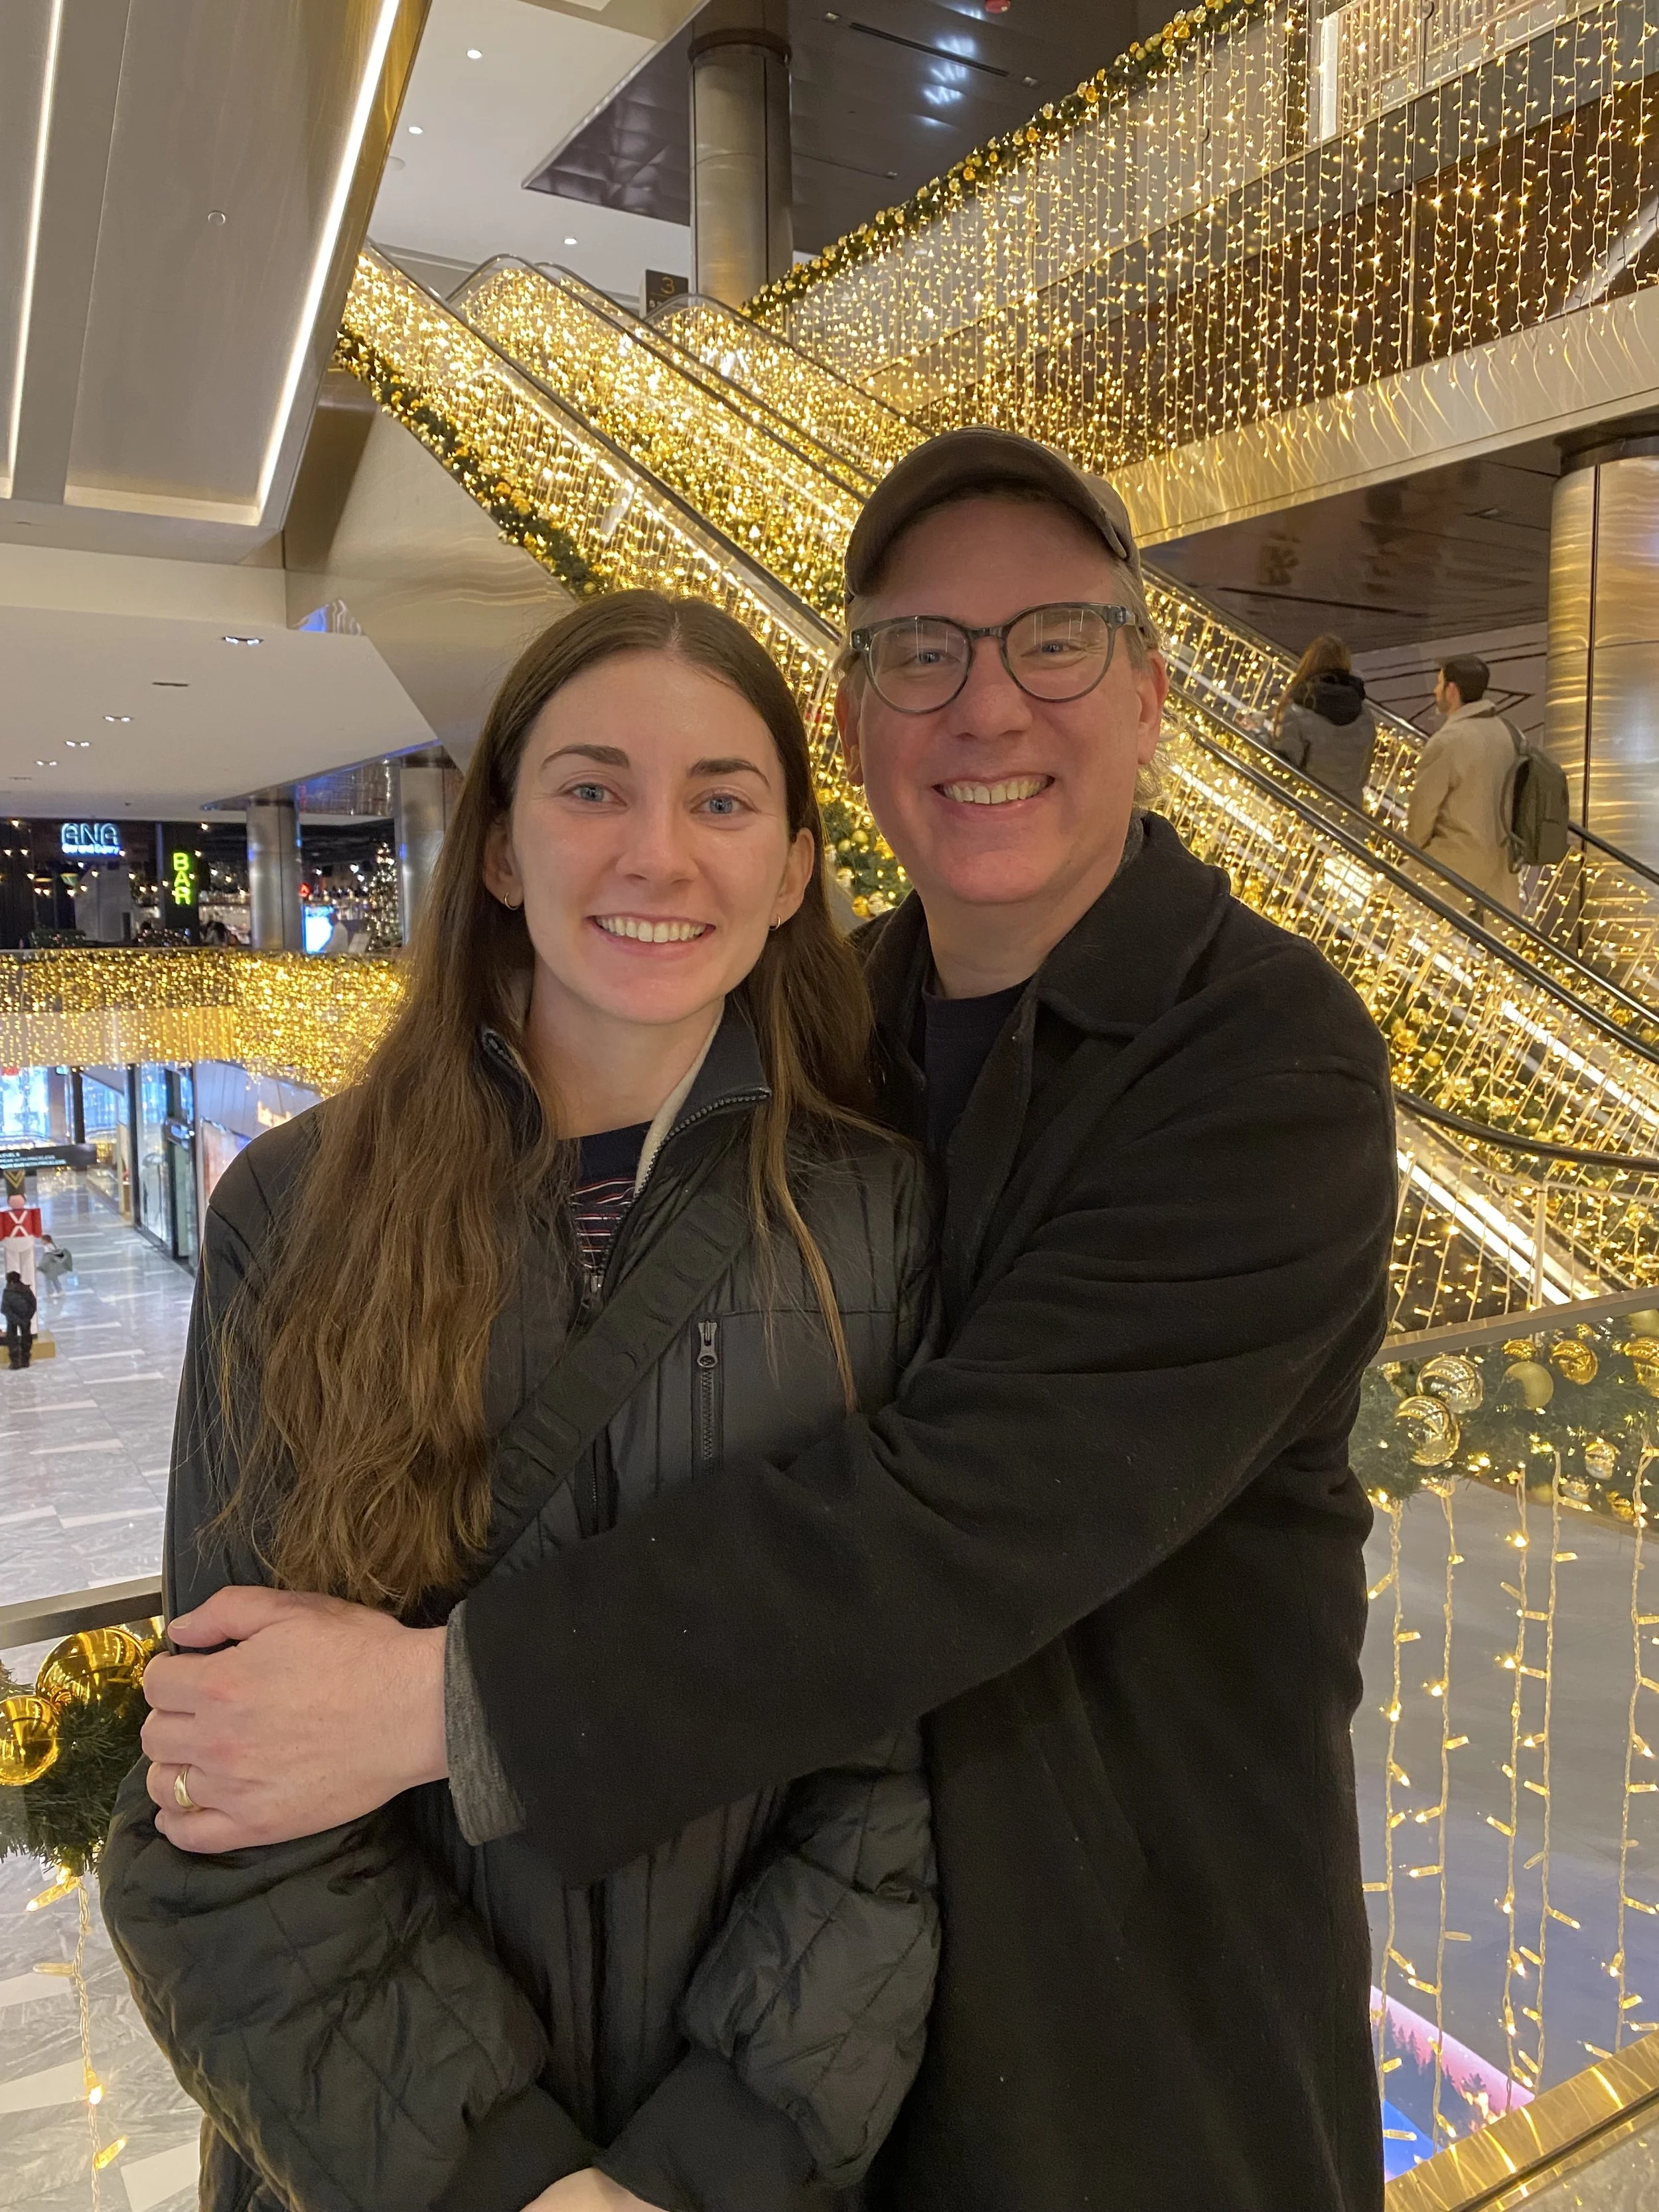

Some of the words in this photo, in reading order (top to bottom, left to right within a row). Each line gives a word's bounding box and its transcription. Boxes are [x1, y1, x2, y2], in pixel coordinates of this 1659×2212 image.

[660, 276, 675, 295] 3
[62, 823, 118, 844] ANA
[173, 852, 190, 905] BAR
